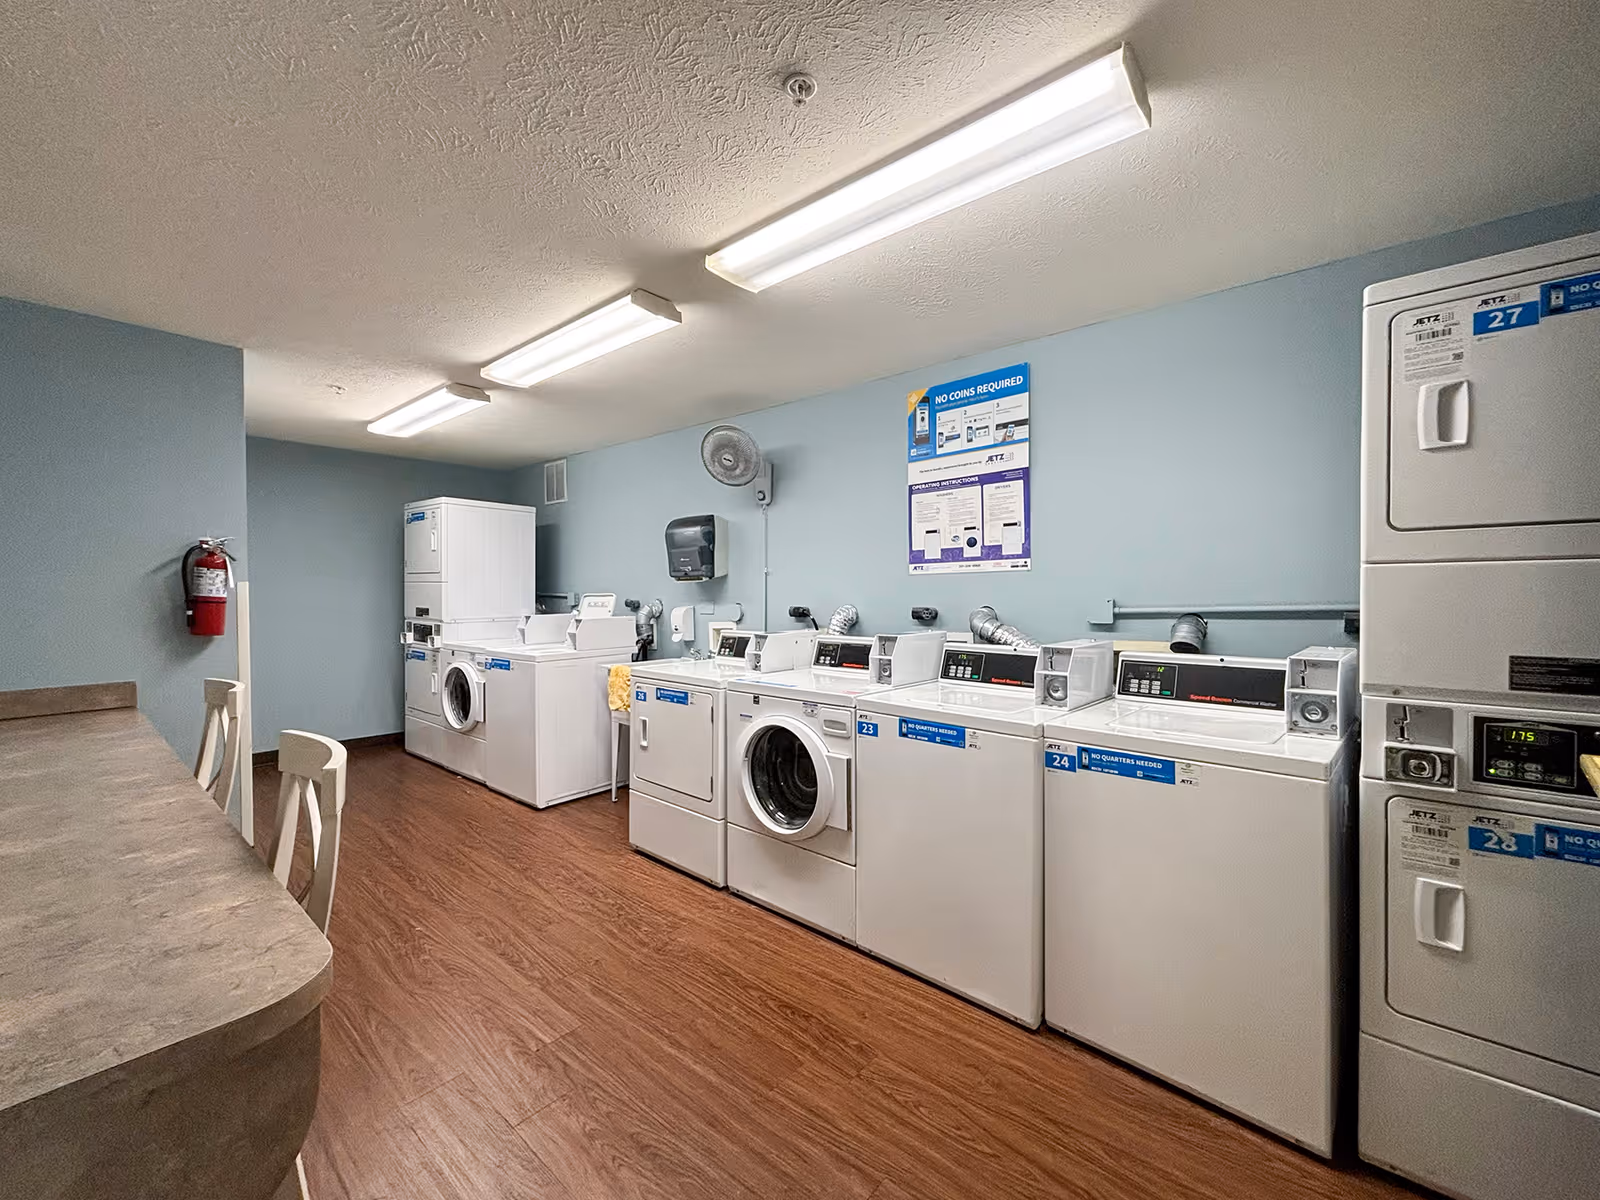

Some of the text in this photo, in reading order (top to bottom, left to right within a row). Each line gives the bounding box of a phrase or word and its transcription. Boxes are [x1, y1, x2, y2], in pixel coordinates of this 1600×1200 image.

[1570, 283, 1589, 293] NO
[1478, 295, 1506, 307] JETZ
[1413, 314, 1440, 326] JETZ
[1488, 307, 1523, 328] 27
[935, 393, 948, 404] NO
[949, 387, 975, 400] COINS
[977, 375, 1023, 394] REQUIRED
[985, 453, 1005, 463] JETZ
[912, 476, 979, 491] OPERATING INSTRUCTIONS
[861, 723, 873, 734] 23
[1511, 730, 1535, 741] 175
[1052, 754, 1070, 768] 24
[1091, 752, 1162, 769] NO QUARTERS NEEDED
[1409, 809, 1437, 819] JETZ
[1472, 816, 1501, 825] JETZ
[1564, 834, 1584, 844] NO
